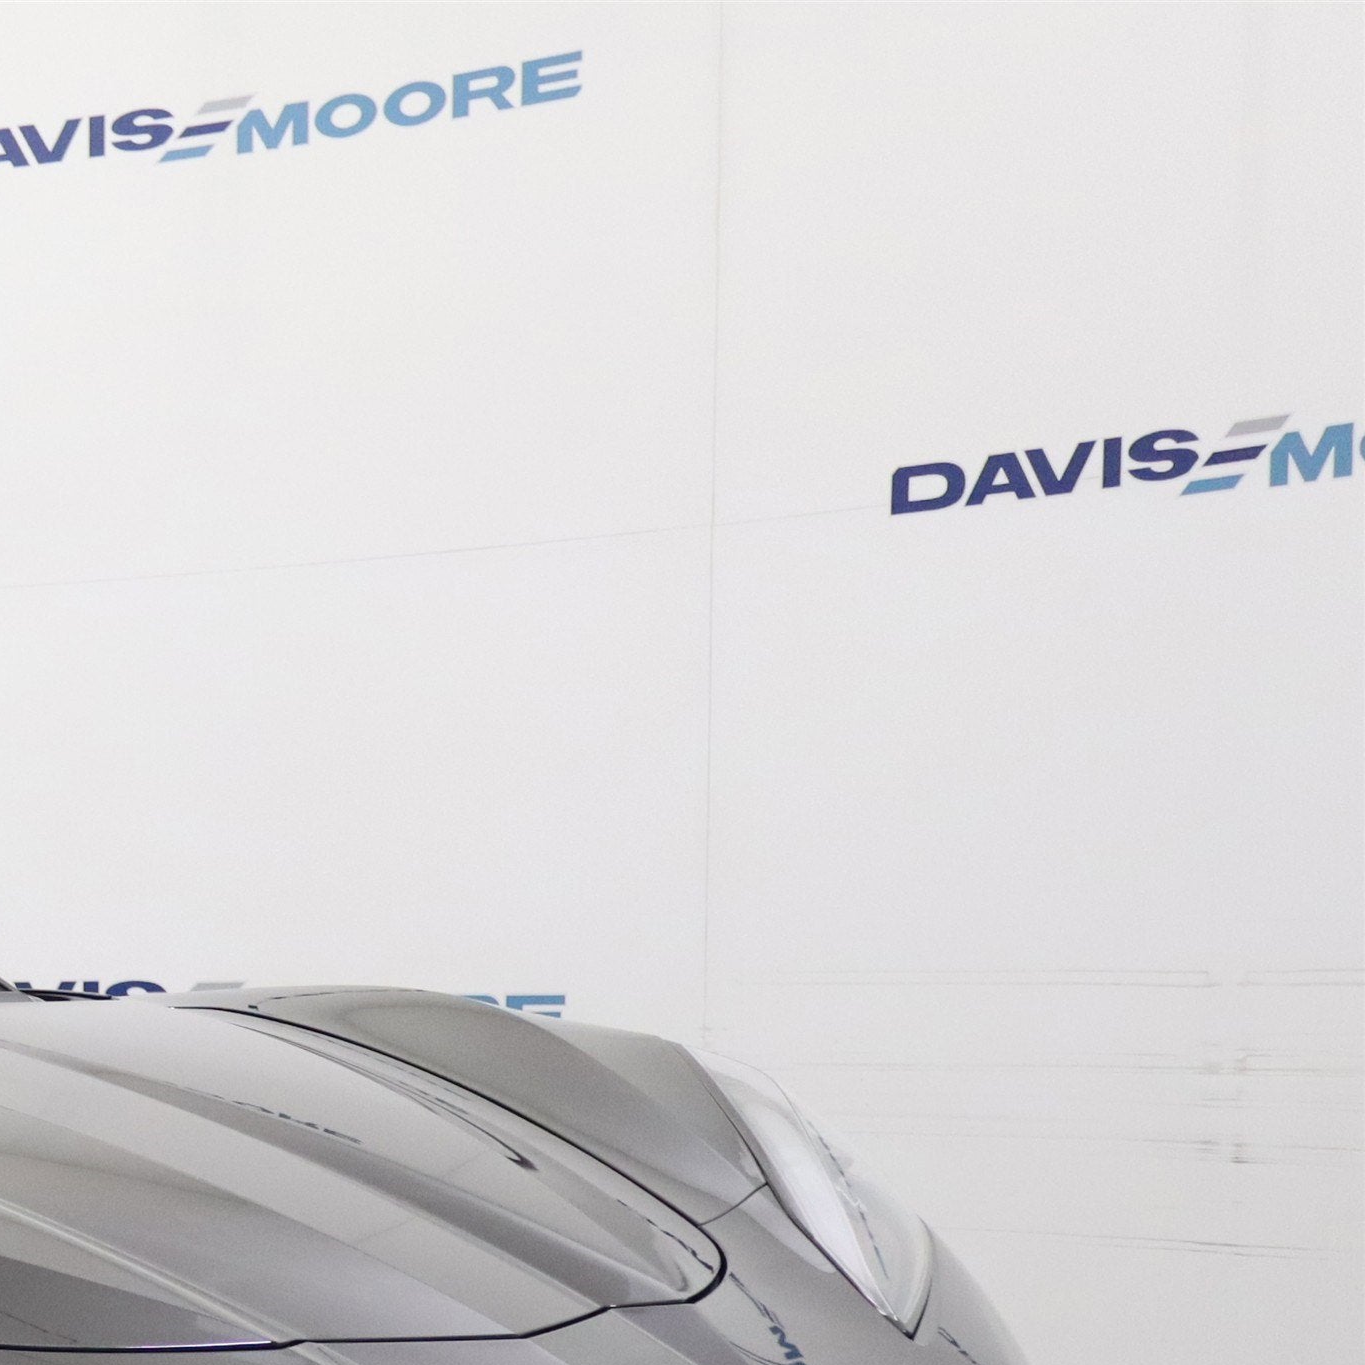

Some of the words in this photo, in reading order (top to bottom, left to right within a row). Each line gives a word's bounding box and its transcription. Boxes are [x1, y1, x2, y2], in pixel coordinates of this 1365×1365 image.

[236, 49, 583, 155] MOORE
[891, 428, 1199, 516] DAVIS
[1269, 421, 1365, 489] M
